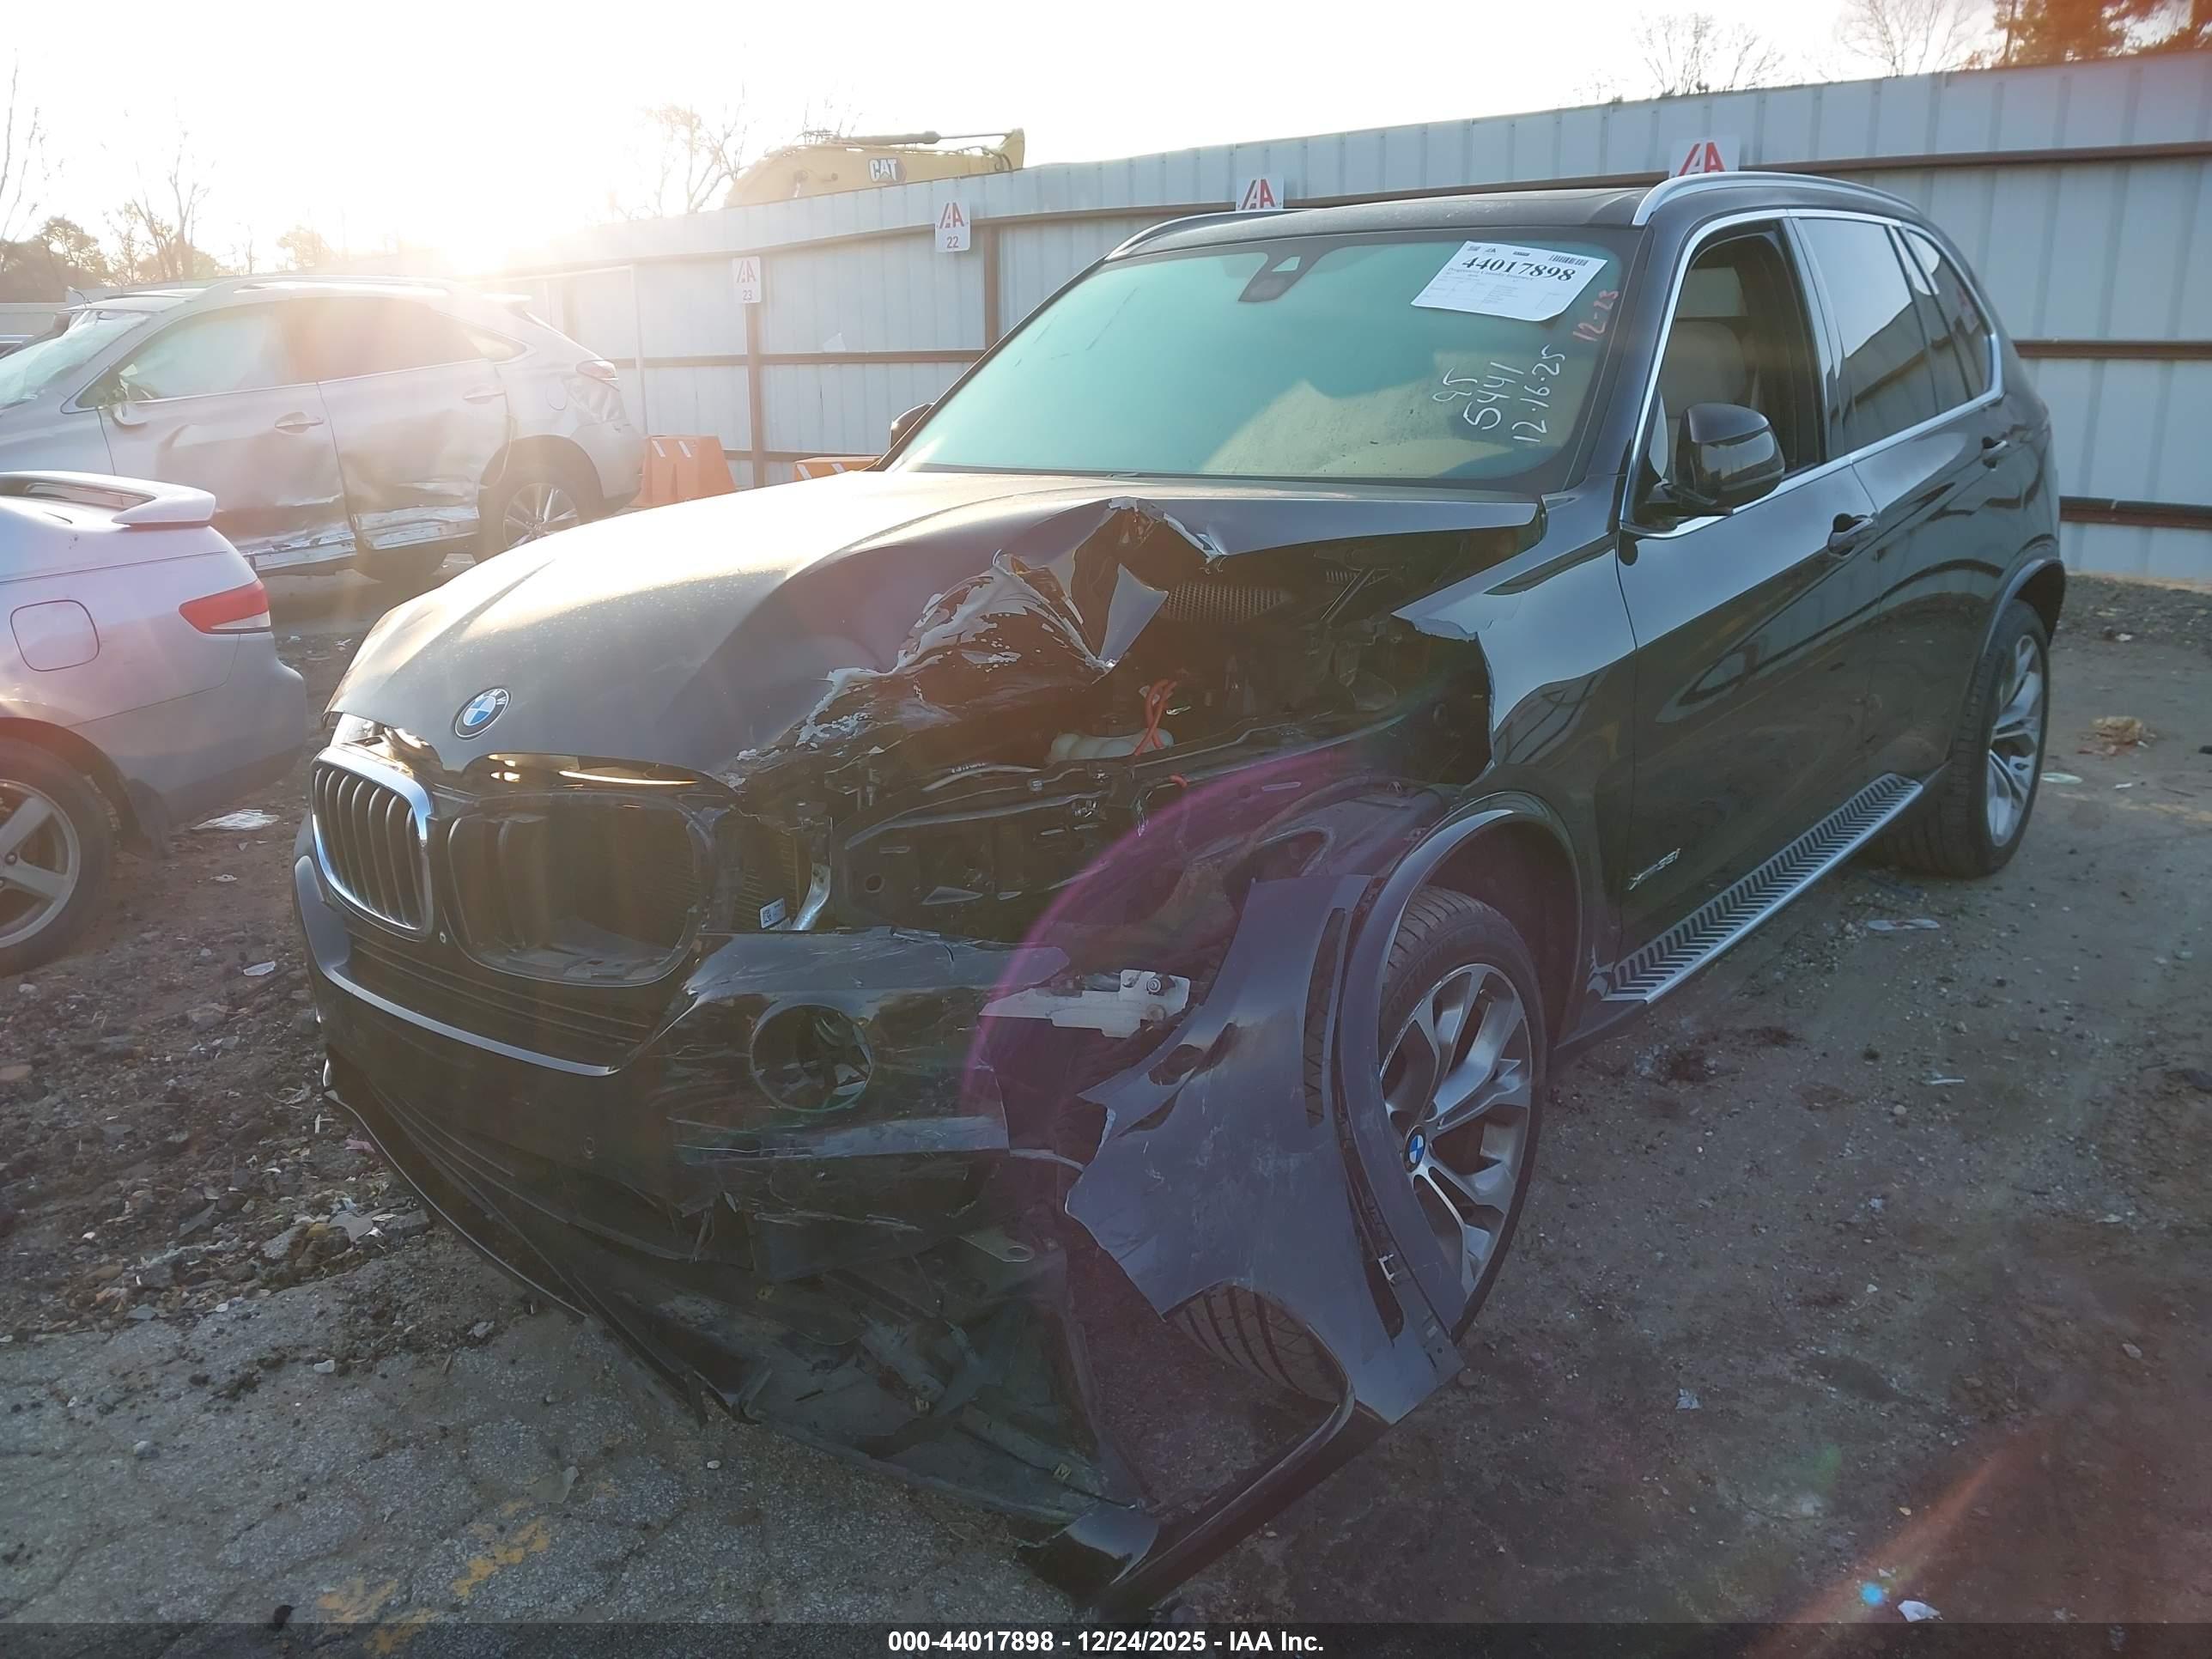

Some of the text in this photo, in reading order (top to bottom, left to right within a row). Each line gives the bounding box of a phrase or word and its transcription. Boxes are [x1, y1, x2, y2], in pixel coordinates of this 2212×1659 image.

[868, 158, 898, 183] CAT
[946, 235, 959, 249] 22
[1462, 257, 1577, 282] 44017898
[742, 289, 753, 301] 23
[1462, 361, 1524, 430] 5441
